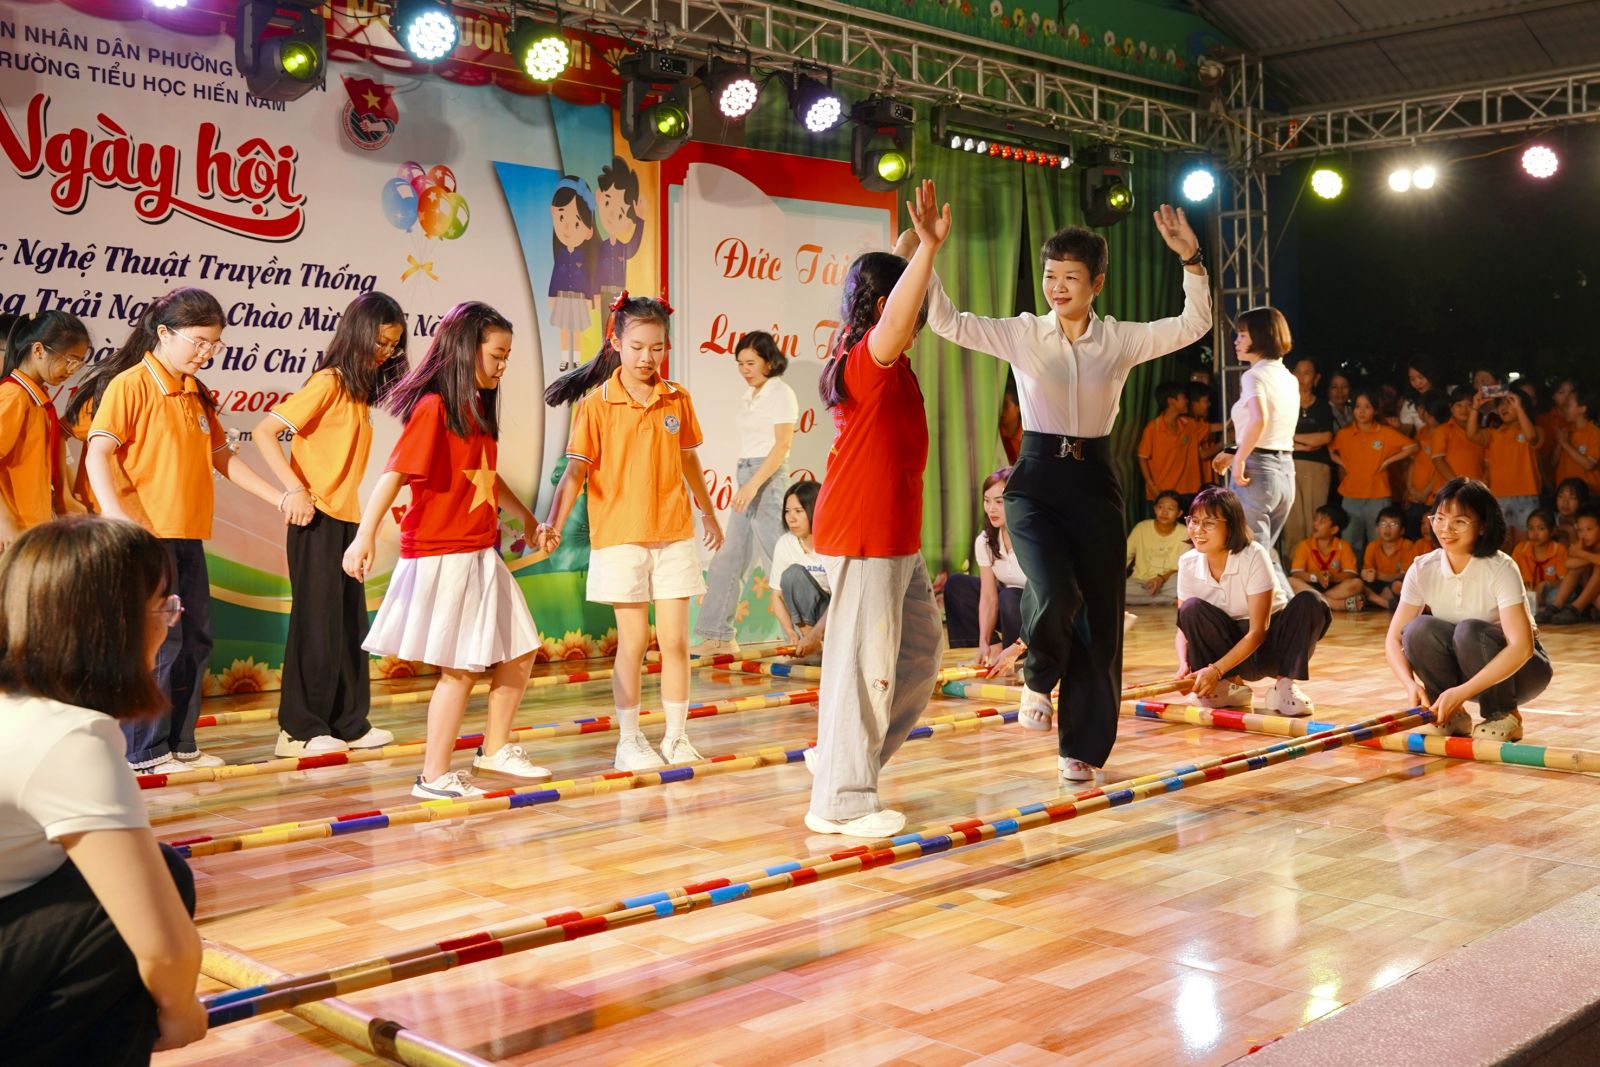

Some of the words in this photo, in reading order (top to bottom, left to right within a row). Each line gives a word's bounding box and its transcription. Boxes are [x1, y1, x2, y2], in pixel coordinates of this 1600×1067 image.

[24, 24, 89, 52] NHÂN
[96, 37, 141, 61] DÂN
[148, 48, 234, 77] PHƯỜNG
[87, 61, 137, 89] TIỂU
[143, 76, 187, 97] HỌC
[193, 80, 239, 105] HIẾN
[0, 92, 184, 225] Ngày
[196, 121, 308, 218] hội
[13, 238, 97, 278] Nghệ
[104, 245, 192, 284] Thuật
[198, 254, 292, 290] Truyền
[300, 263, 378, 295] Thống
[714, 237, 783, 281] Đức
[795, 243, 850, 286] Tài
[36, 288, 103, 318] Trải
[226, 302, 293, 330] Chào
[222, 342, 260, 372] Hồ
[264, 348, 307, 374] Chí
